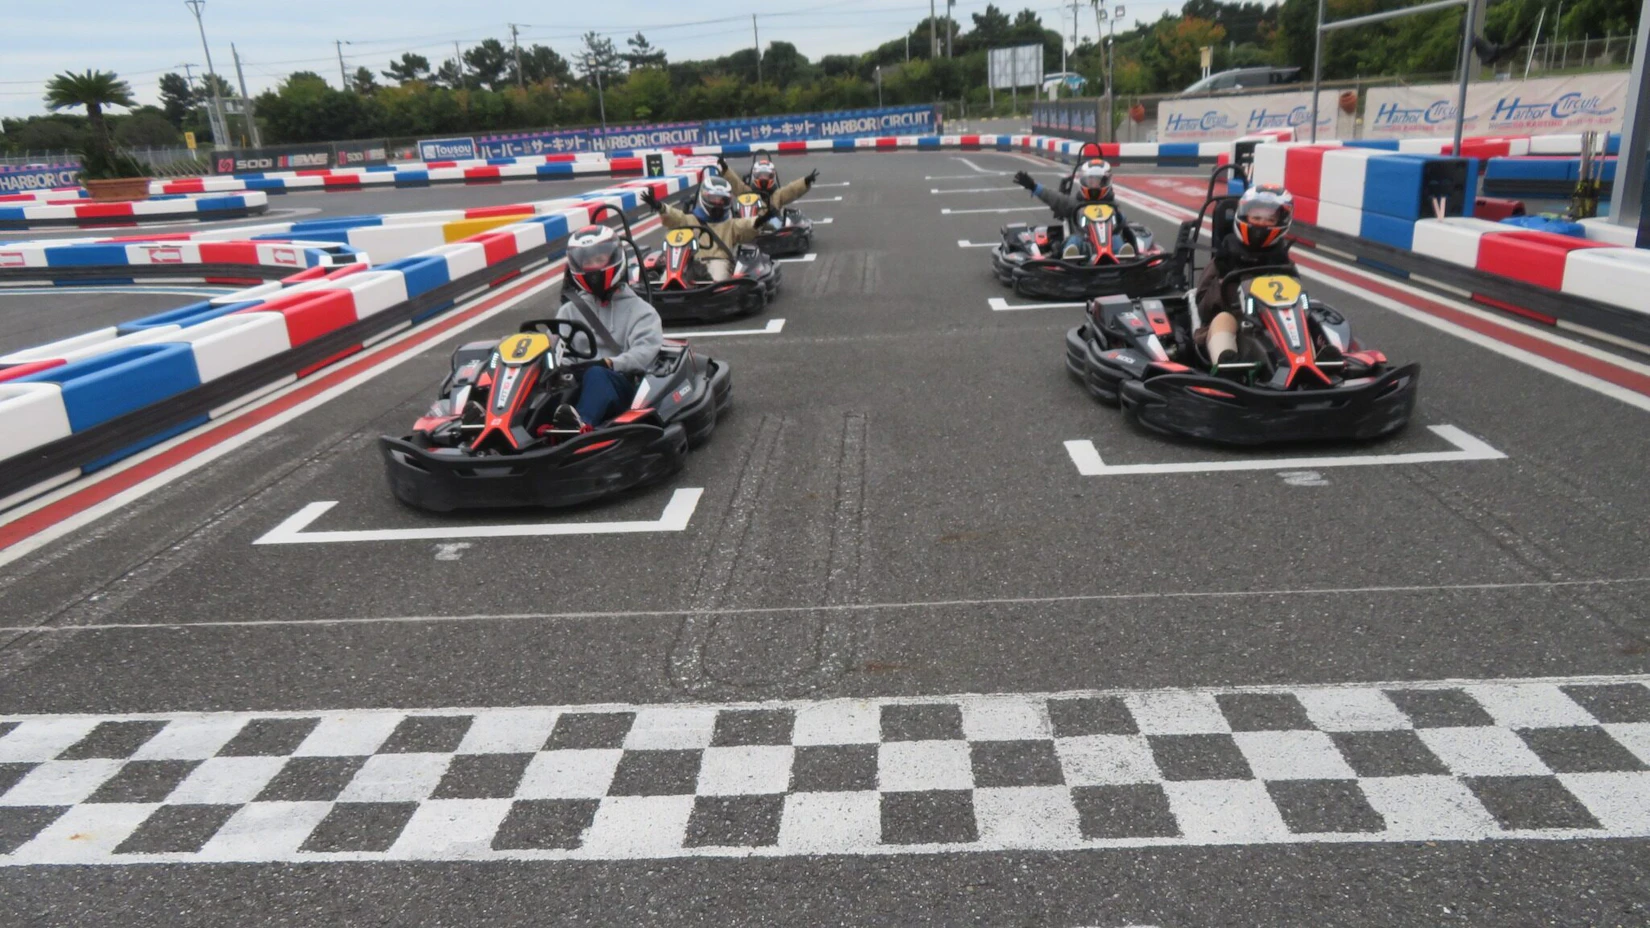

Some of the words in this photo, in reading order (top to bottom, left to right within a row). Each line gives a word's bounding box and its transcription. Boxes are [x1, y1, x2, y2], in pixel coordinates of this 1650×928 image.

[1374, 103, 1424, 124] Harbor
[1491, 96, 1550, 121] Harbor
[1551, 92, 1606, 119] Circuit
[822, 117, 877, 136] HARBOR
[881, 111, 930, 128] CIRCUIT
[1165, 113, 1200, 131] Harbor
[1200, 110, 1233, 130] Circuit
[1247, 109, 1288, 128] Harbor
[651, 129, 699, 145] CIRCUIT
[760, 120, 815, 139] サーキット
[531, 135, 585, 153] サーキット
[0, 173, 56, 191] HARBOR
[675, 231, 684, 243] 6
[1268, 281, 1289, 301] 2
[511, 338, 532, 358] 8
